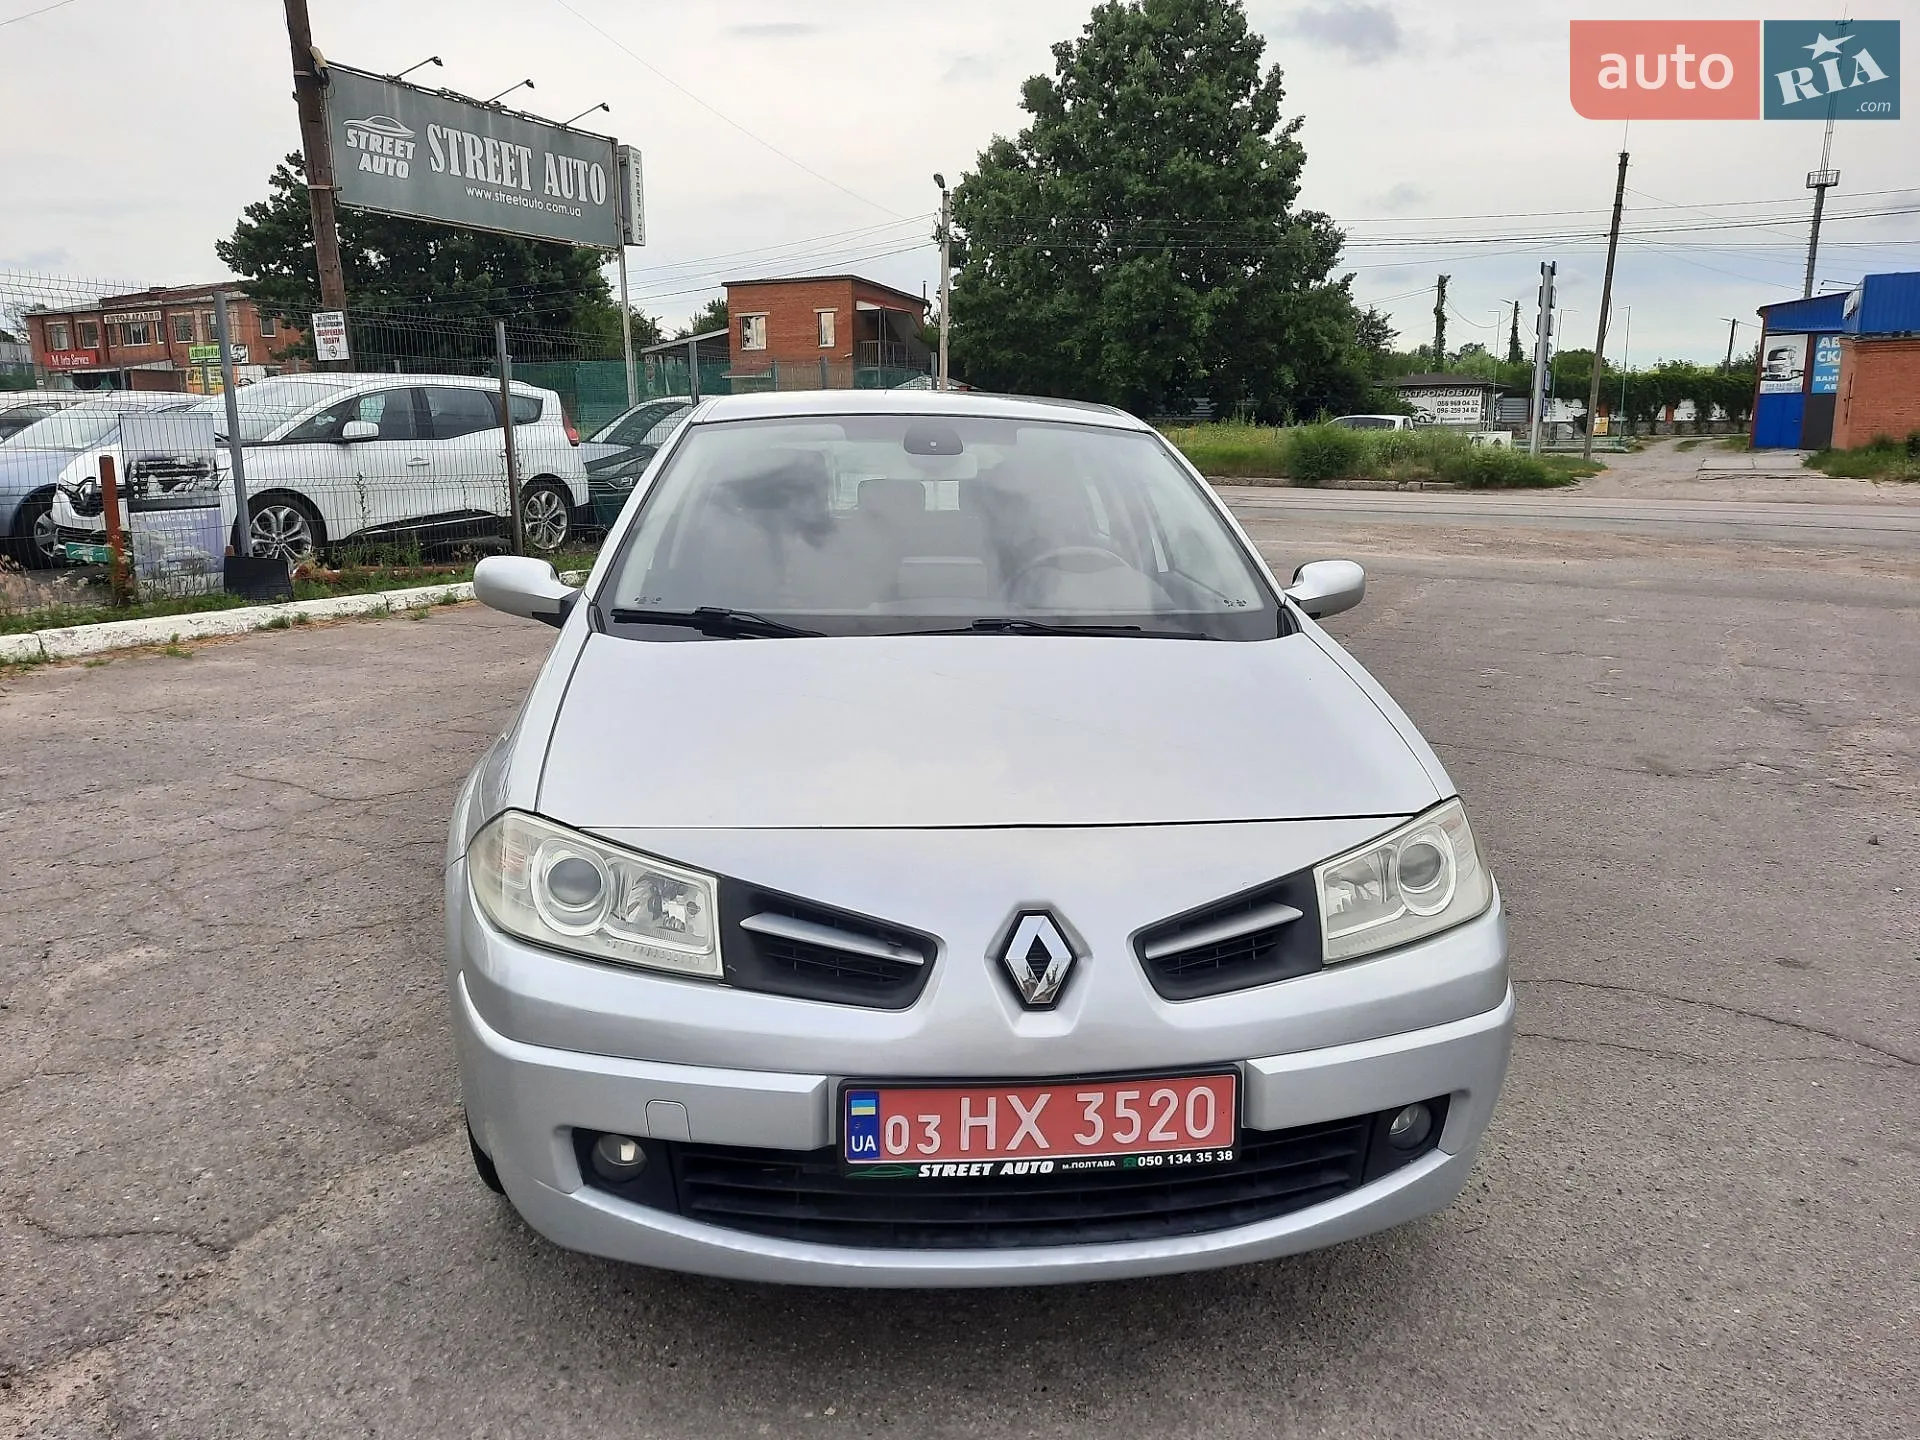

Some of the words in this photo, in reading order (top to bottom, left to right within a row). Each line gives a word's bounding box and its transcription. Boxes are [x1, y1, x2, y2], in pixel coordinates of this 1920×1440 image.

[346, 129, 416, 160] STREET
[359, 152, 409, 179] AUTO
[426, 123, 533, 192] STREET
[544, 151, 607, 206] AUTO
[465, 185, 581, 217] www.streetauto.com.ua
[851, 1134, 877, 1152] UA
[884, 1114, 941, 1155] 03
[960, 1093, 1052, 1152] HX
[1074, 1086, 1216, 1146] 3520
[918, 1163, 994, 1178] STREET
[1000, 1161, 1055, 1176] AUTO
[1062, 1159, 1116, 1170] м.ПОЛТАВА
[1137, 1155, 1163, 1167] 050
[1167, 1153, 1192, 1165] 134
[1195, 1151, 1213, 1163] 35
[1216, 1150, 1233, 1162] 38
